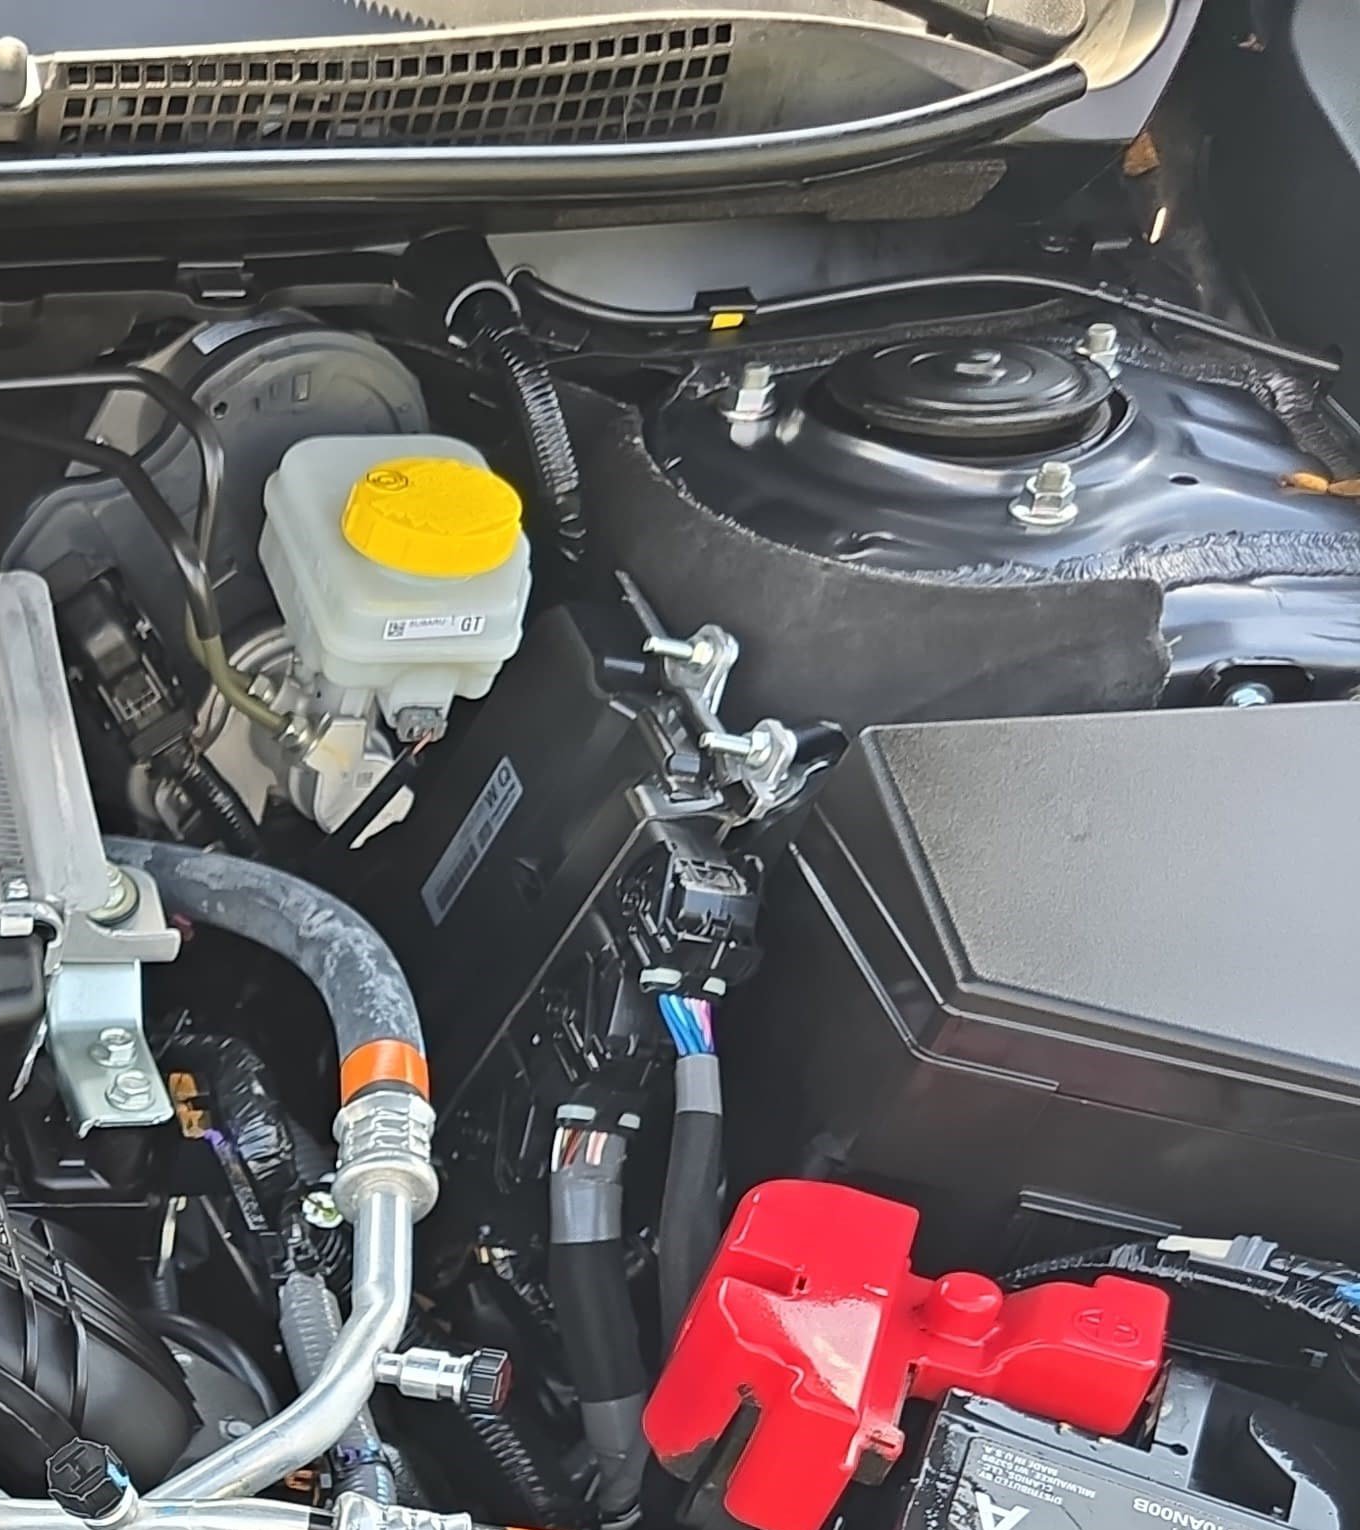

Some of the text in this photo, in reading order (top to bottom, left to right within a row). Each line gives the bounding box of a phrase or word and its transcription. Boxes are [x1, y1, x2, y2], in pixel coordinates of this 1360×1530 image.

[461, 616, 484, 632] GT
[1014, 1454, 1026, 1465] IN
[1029, 1458, 1058, 1476] MADE
